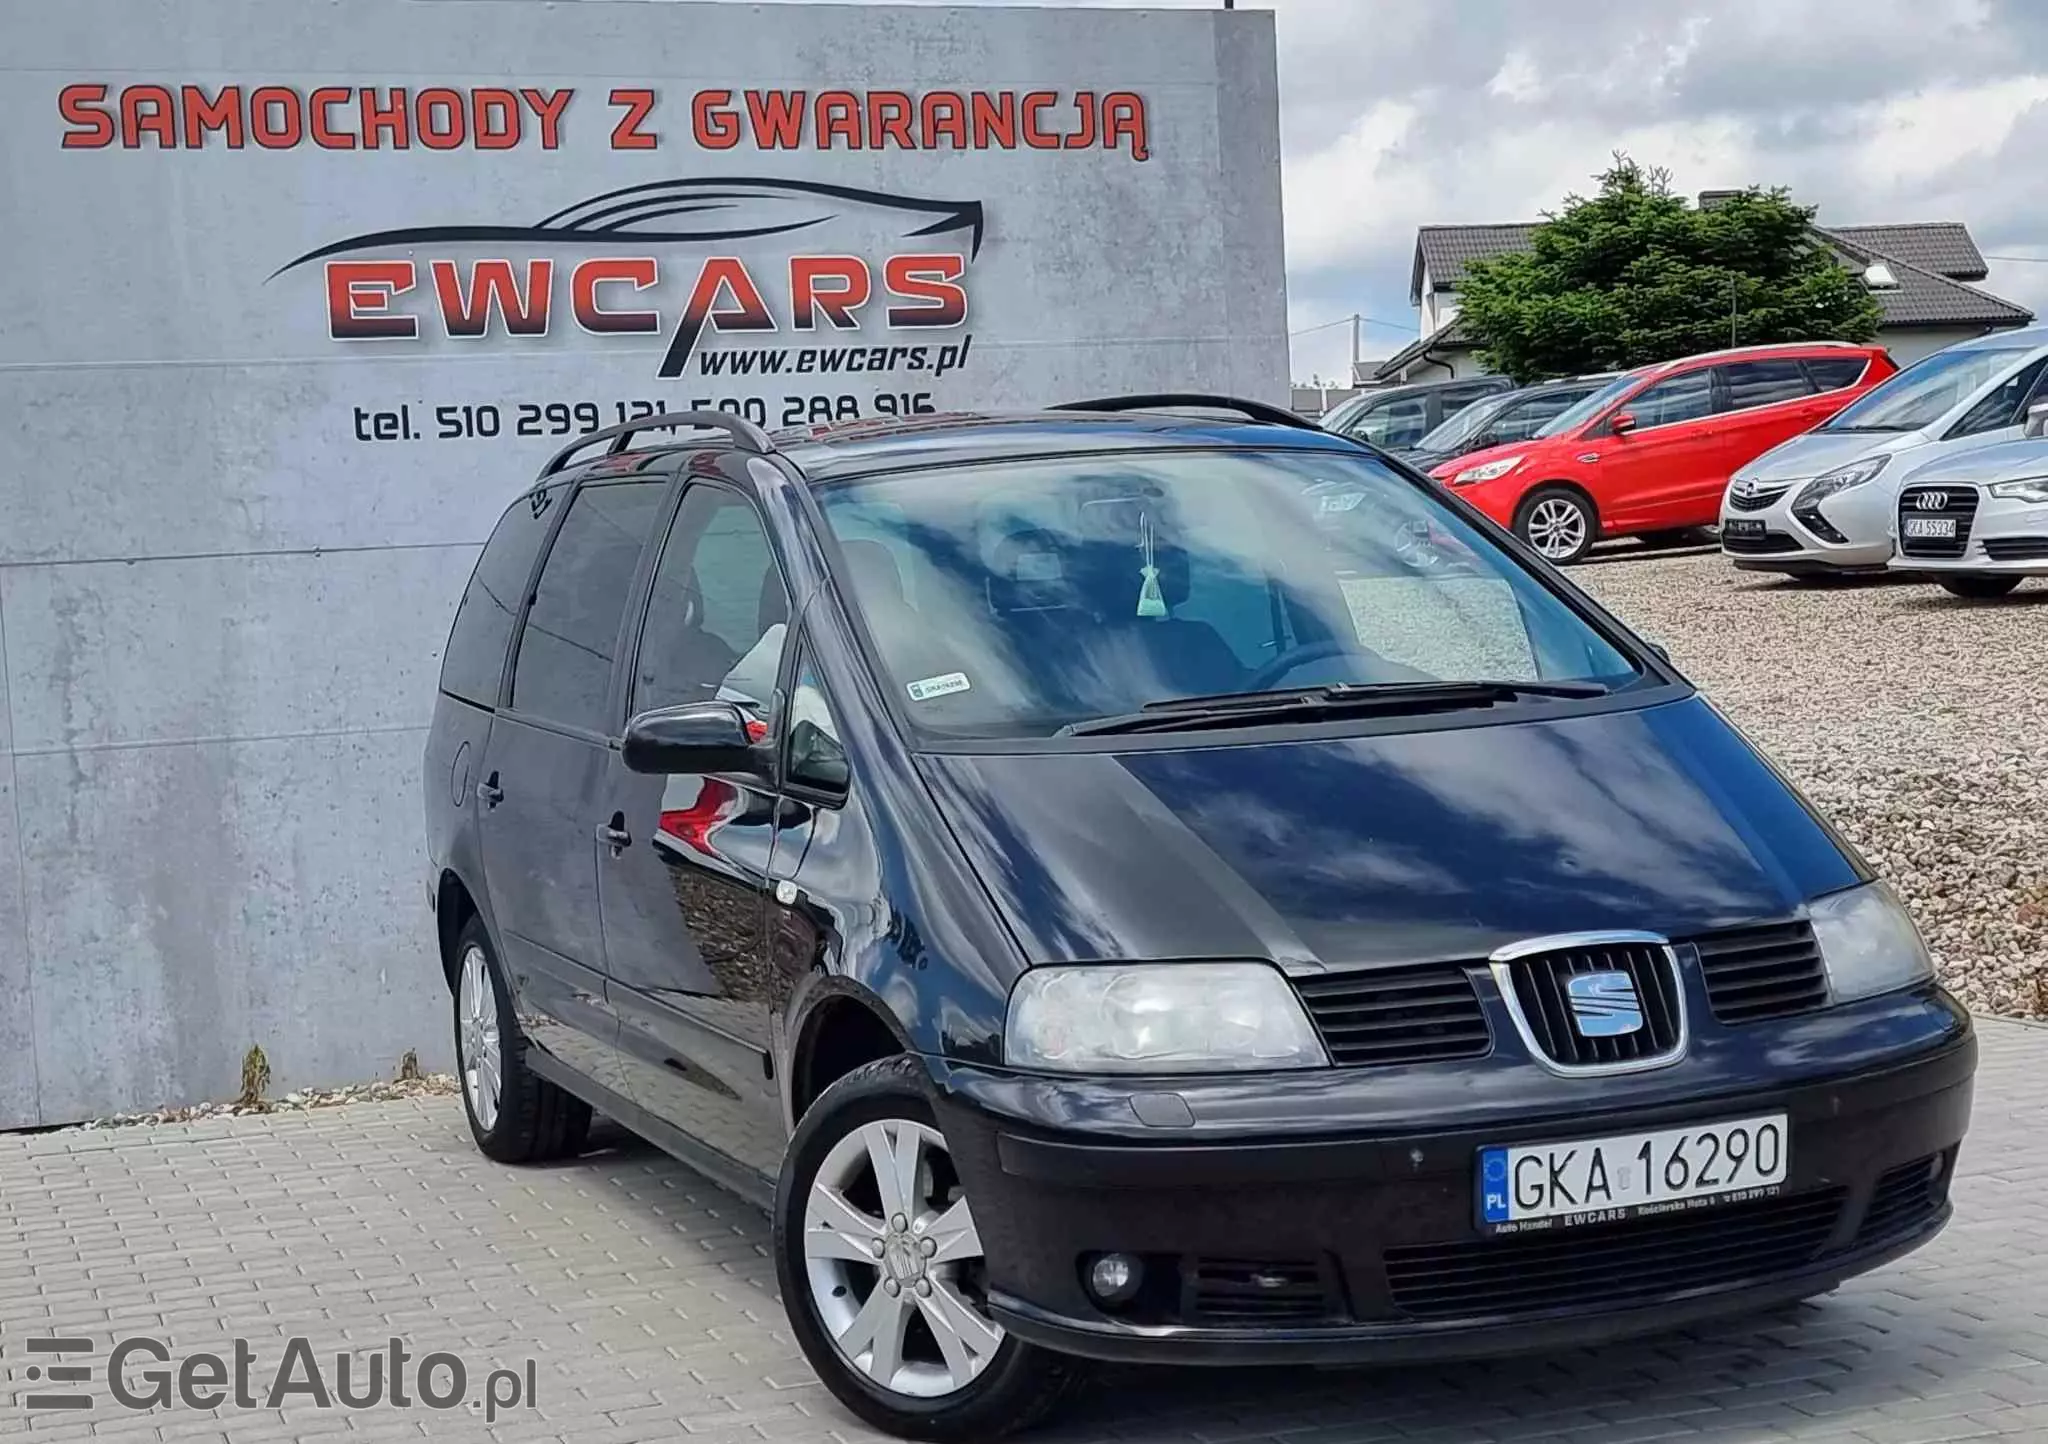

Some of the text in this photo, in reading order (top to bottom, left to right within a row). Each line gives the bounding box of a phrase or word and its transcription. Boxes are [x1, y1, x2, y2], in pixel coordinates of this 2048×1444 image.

[58, 84, 1150, 162] SAMOCHODY Z GWARANCJĄ
[324, 253, 969, 379] EWCARS
[700, 334, 972, 377] www.ewcars.pl
[353, 403, 421, 442] tel.
[435, 404, 501, 440] 510
[516, 401, 600, 436] 299
[1514, 1123, 1780, 1211] GKA 16290
[1486, 1194, 1507, 1211] PL
[1564, 1208, 1626, 1227] EWCARS
